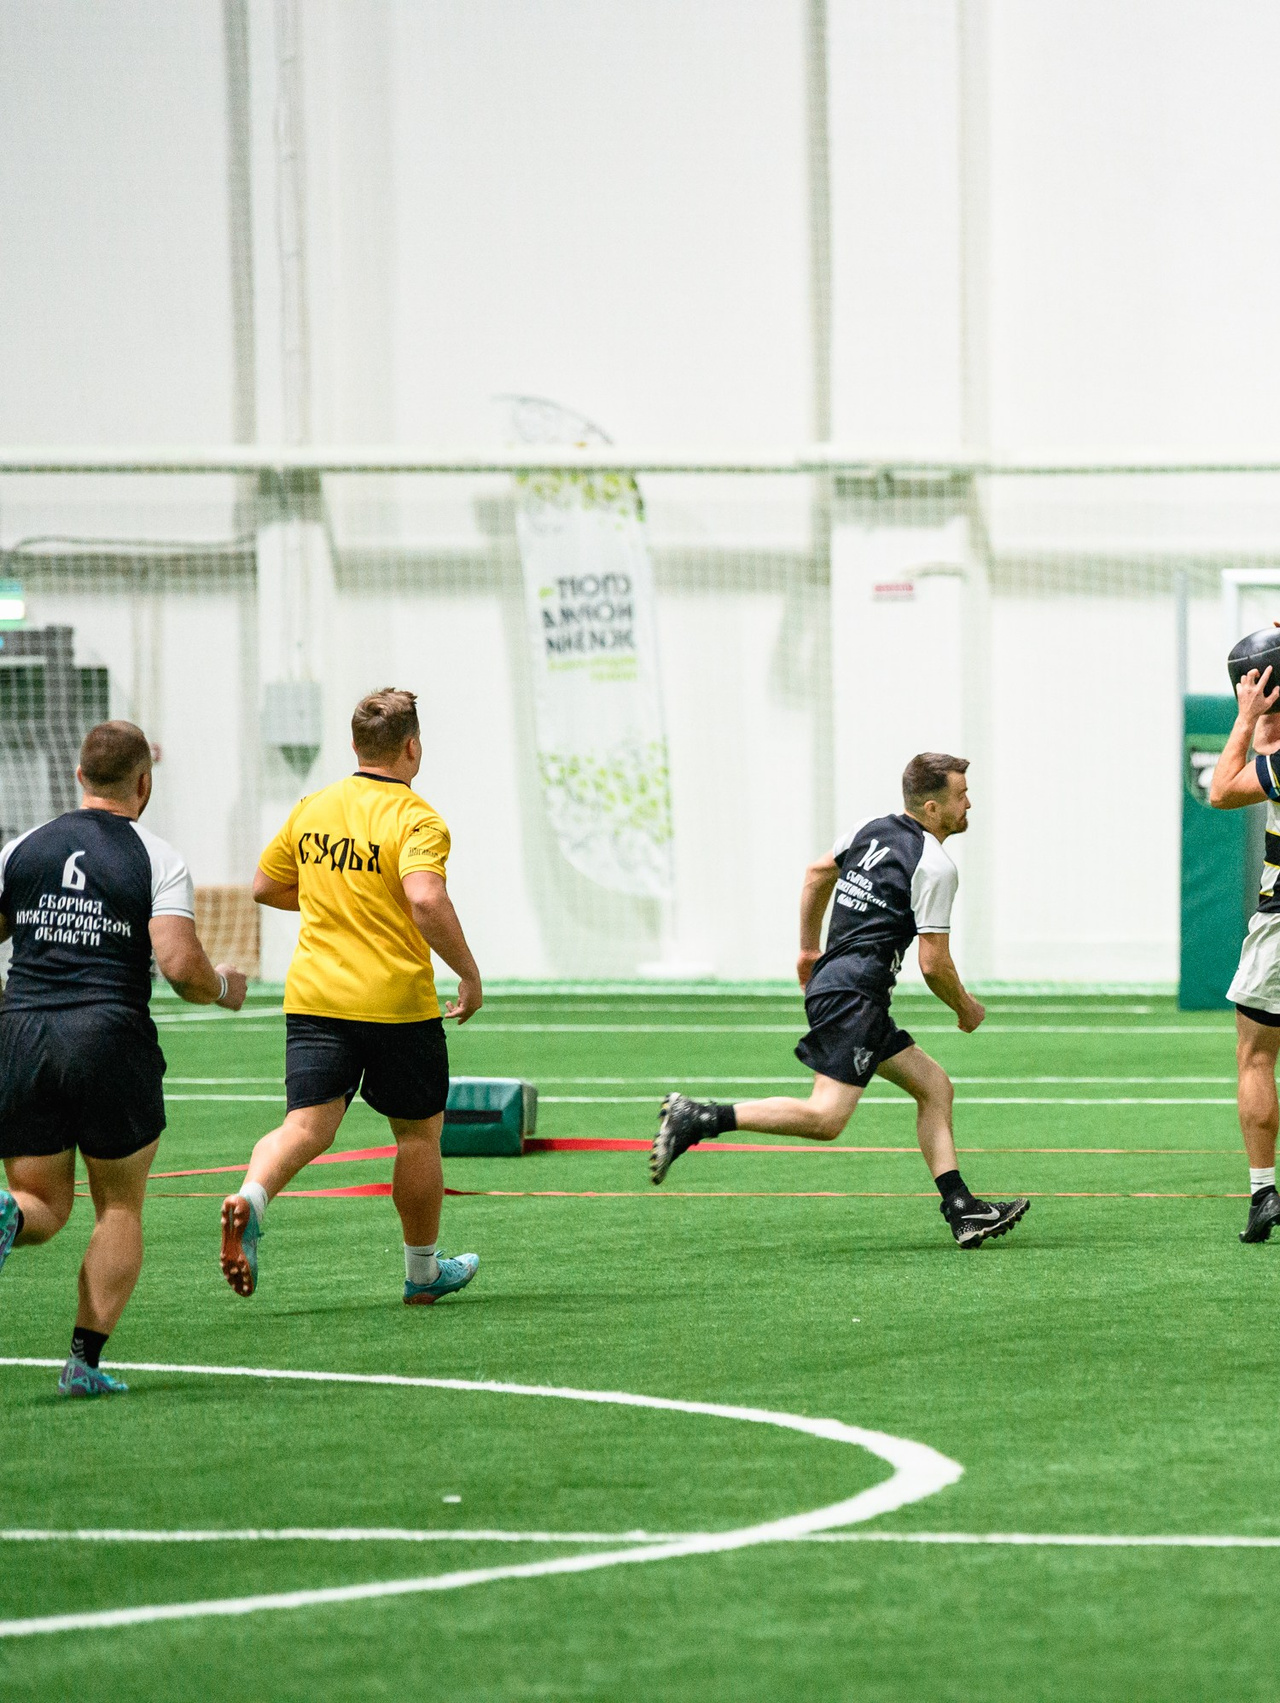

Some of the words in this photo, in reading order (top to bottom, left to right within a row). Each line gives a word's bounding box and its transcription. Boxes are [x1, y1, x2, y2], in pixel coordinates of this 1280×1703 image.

[298, 833, 382, 874] СУДЬЯ
[61, 850, 86, 891] 6
[38, 893, 103, 916] СБОРНАЯ
[16, 909, 131, 938] НИЖЕГОРОДСКОЙ
[34, 926, 102, 947] ОБЛАСТИ
